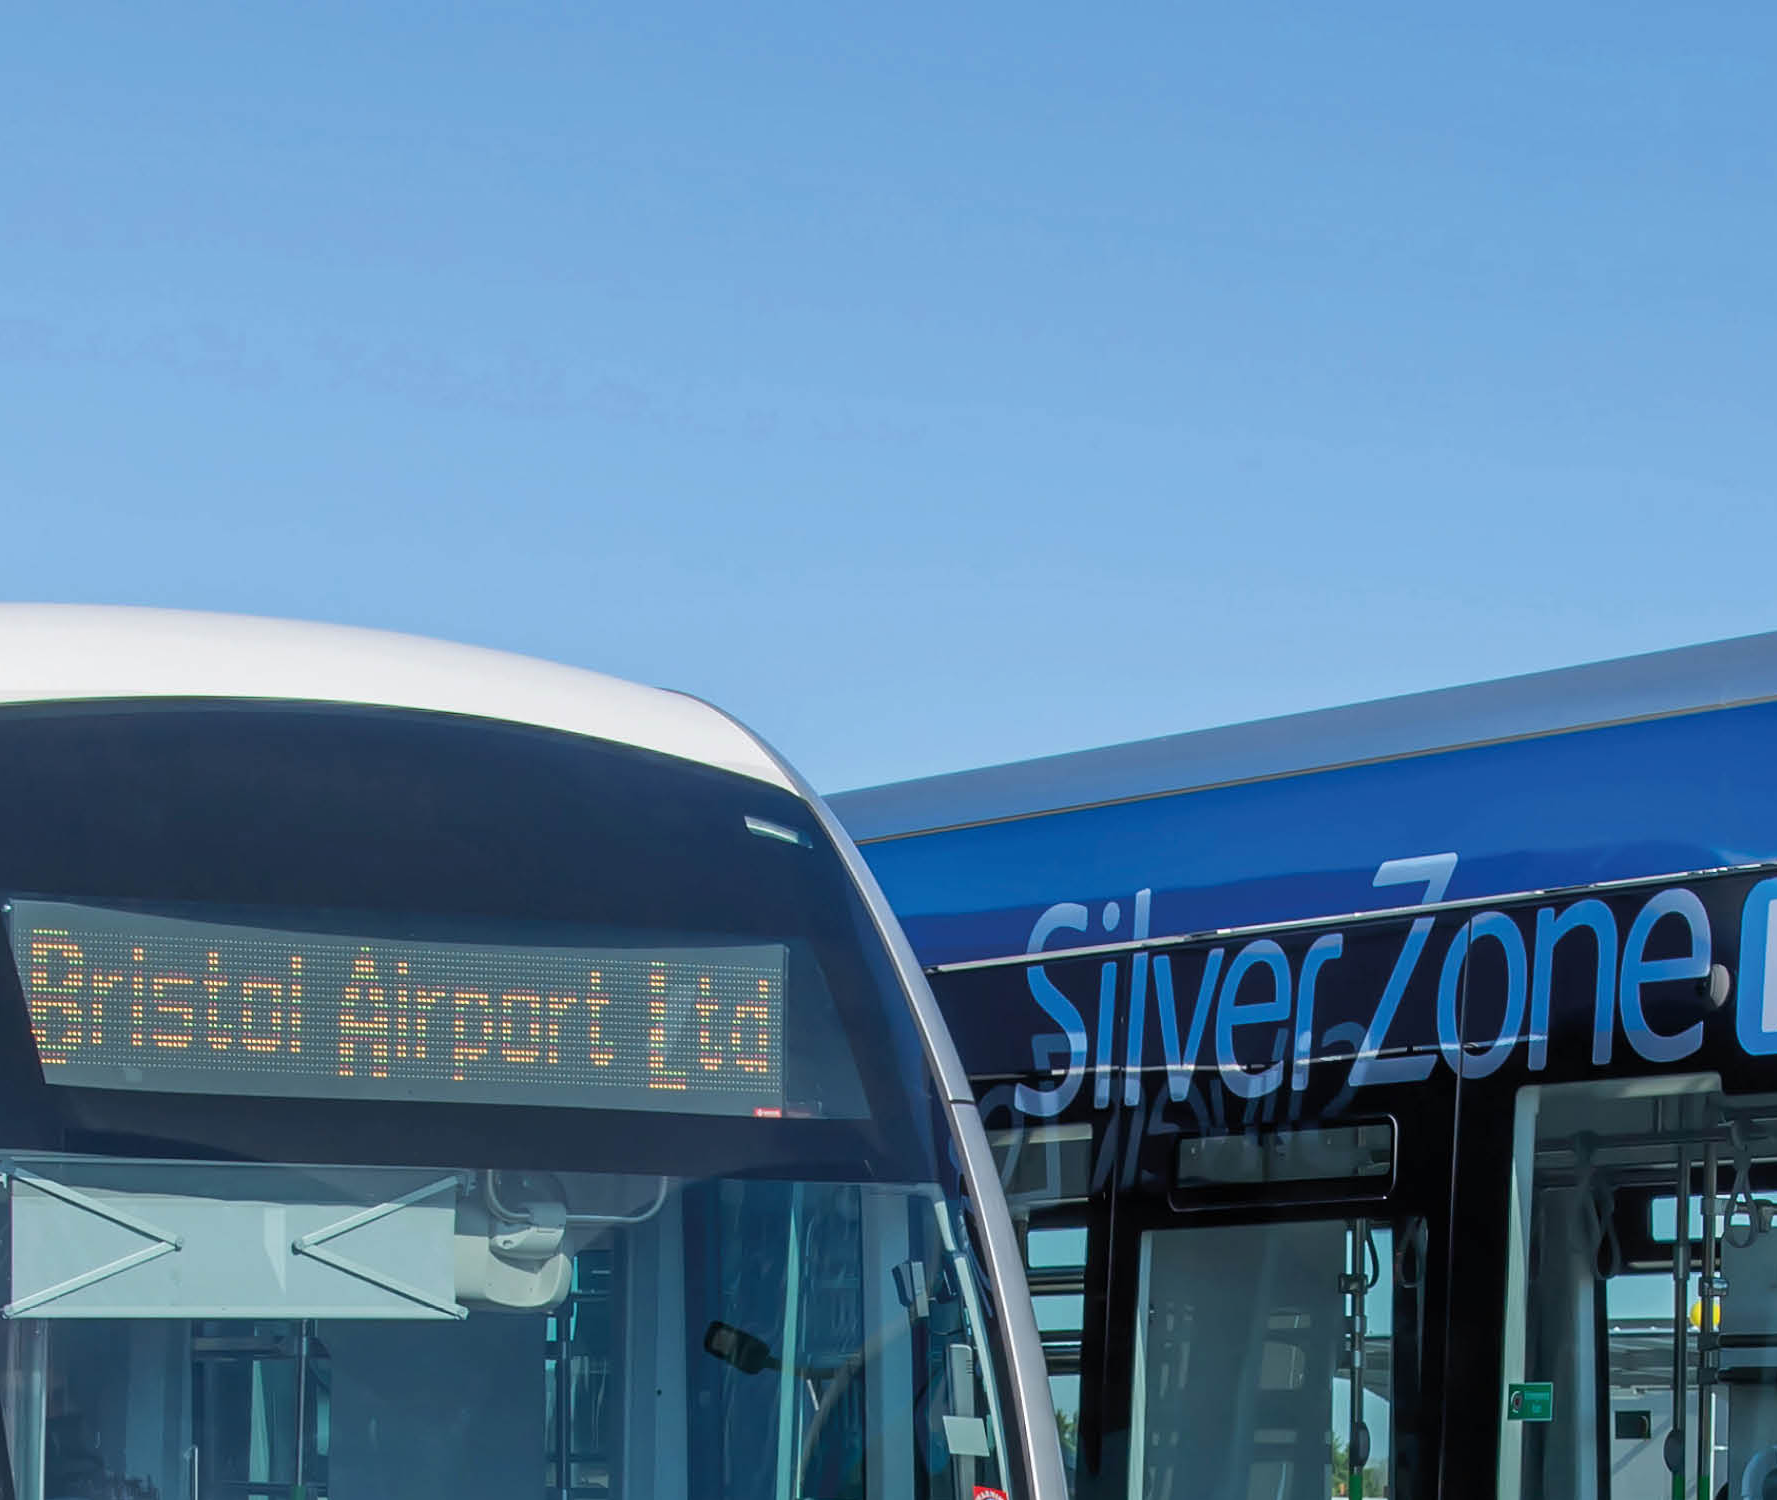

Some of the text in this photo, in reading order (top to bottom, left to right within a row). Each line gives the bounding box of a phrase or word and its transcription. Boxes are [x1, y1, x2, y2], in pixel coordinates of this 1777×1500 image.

[30, 929, 772, 1089] Bristol Airport Ltd
[1014, 888, 1344, 1118] Silver
[1348, 852, 1712, 1087] Zone
